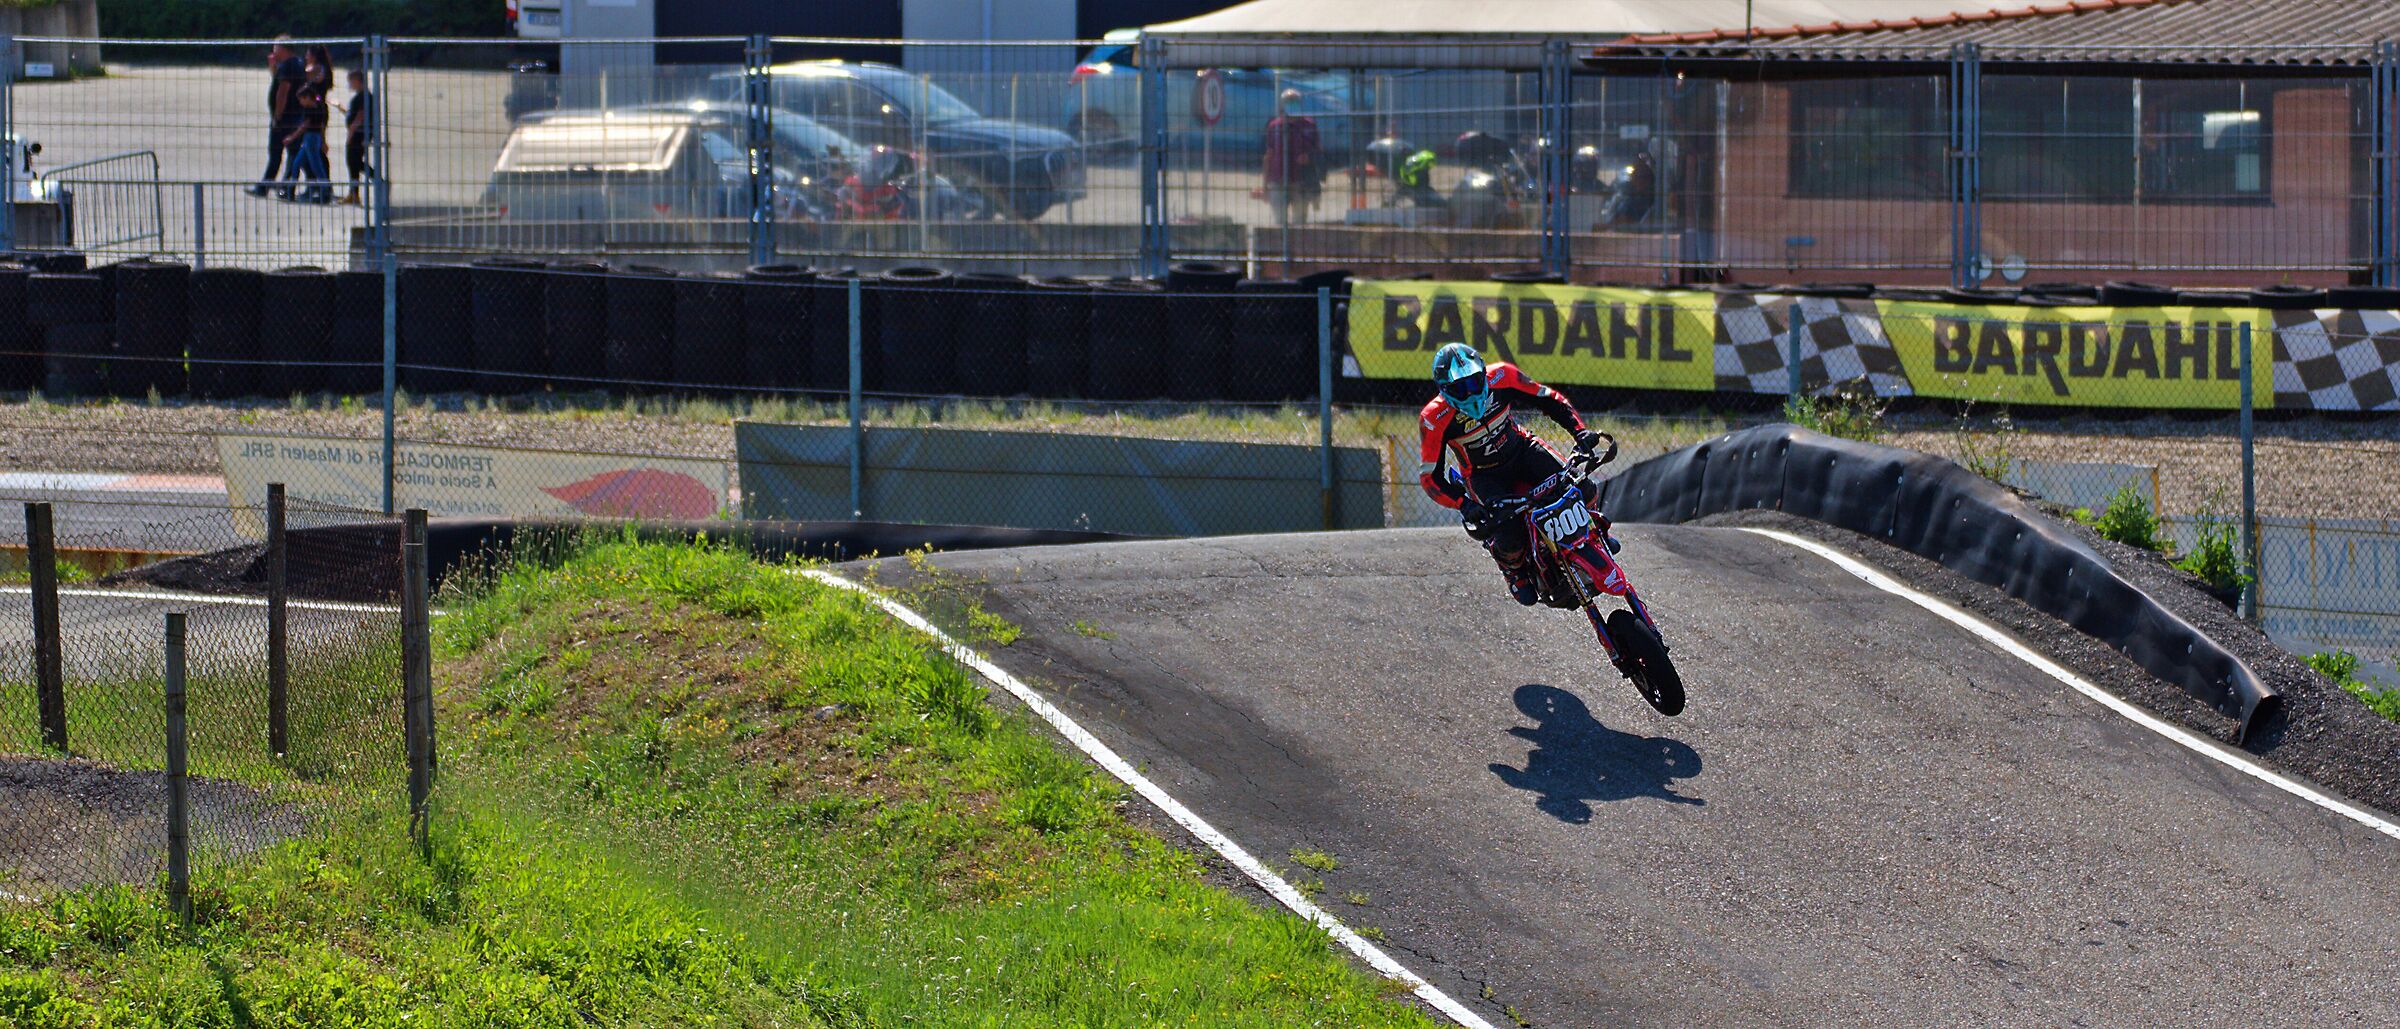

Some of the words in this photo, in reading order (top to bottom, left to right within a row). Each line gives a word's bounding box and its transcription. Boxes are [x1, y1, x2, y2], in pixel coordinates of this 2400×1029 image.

[1383, 294, 1693, 364] BARDAHL
[1934, 315, 2241, 396] BARDAHL
[1544, 500, 1590, 542] 800
